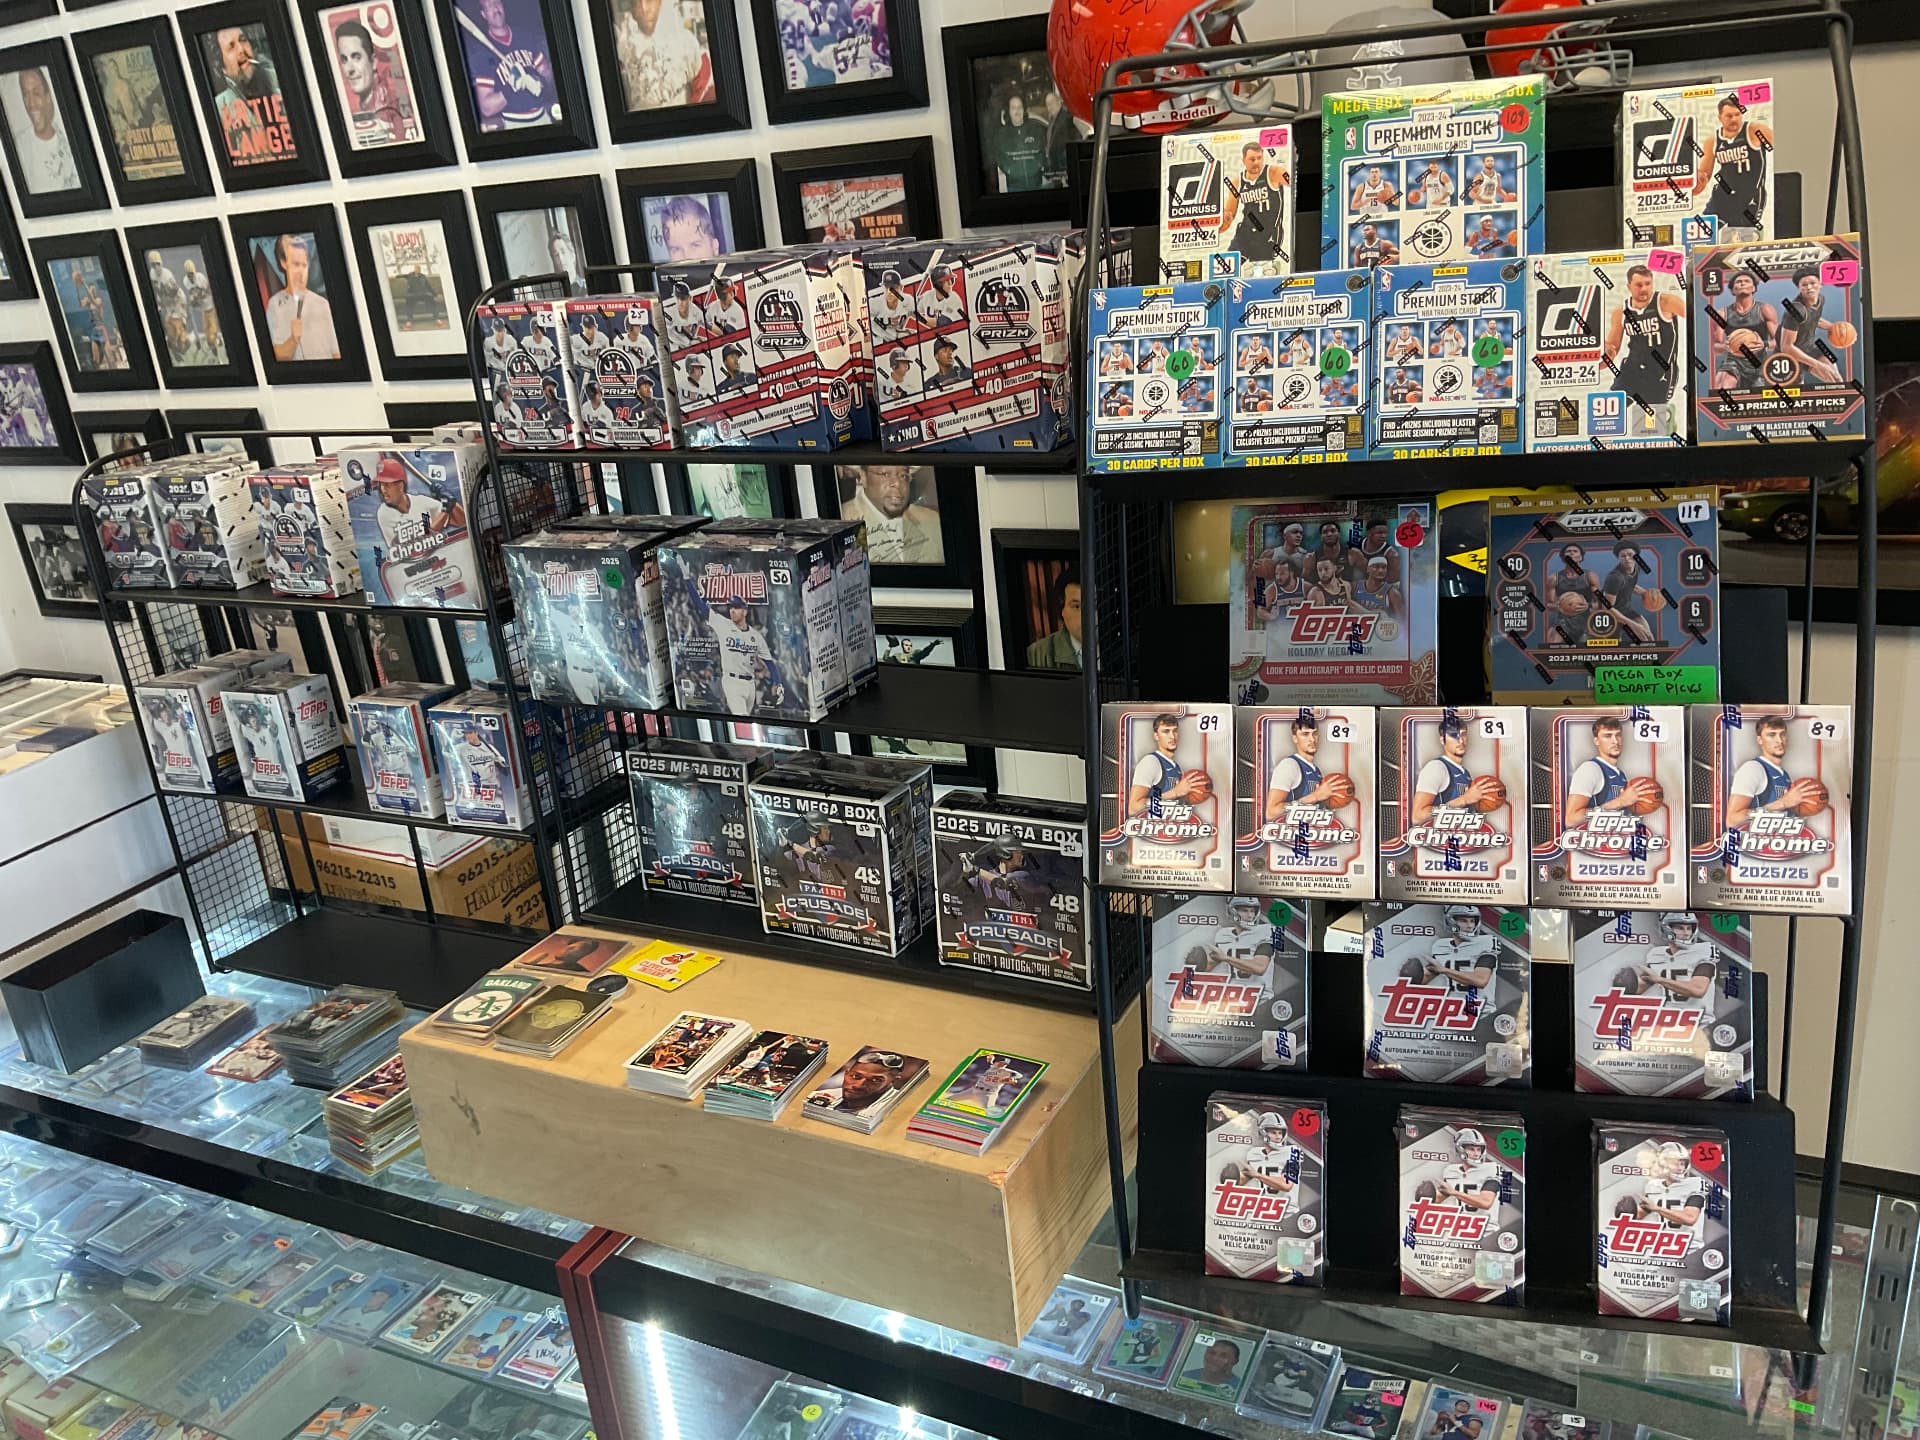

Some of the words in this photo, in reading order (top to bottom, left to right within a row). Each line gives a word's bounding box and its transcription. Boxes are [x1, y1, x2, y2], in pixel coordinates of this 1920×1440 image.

[1743, 85, 1769, 101] 75
[222, 94, 287, 130] ARTIE
[1171, 106, 1216, 121] Riddell
[1333, 100, 1369, 114] MEGA
[1418, 112, 1447, 122] 2023-24
[1506, 110, 1523, 124] 109
[1374, 124, 1441, 145] PREMIUM
[1446, 120, 1493, 137] STOCK
[225, 124, 295, 158] LANGE
[1398, 145, 1412, 154] NBA
[1413, 142, 1443, 153] TRADING
[1637, 165, 1690, 177] DONRUSS
[1734, 160, 1750, 174] 77
[1637, 192, 1689, 207] 2023-24
[1171, 205, 1217, 216] DONRUSS
[1656, 255, 1681, 269] 75
[1003, 271, 1020, 285] 40
[1709, 271, 1717, 284] 5
[1826, 267, 1848, 281] 75
[779, 289, 794, 300] 40
[1403, 295, 1457, 309] PREMIUM
[1115, 313, 1164, 328] PREMIUM
[1166, 311, 1200, 324] STOCK
[1253, 305, 1305, 320] PREMIUM
[1434, 309, 1458, 317] TRADING
[981, 329, 1029, 339] PRIZM
[761, 337, 804, 347] PRIZM
[1540, 336, 1597, 348] DONRUSS
[1479, 342, 1499, 357] 60
[1171, 357, 1189, 372] 60
[1325, 355, 1344, 370] 60
[1773, 359, 1790, 374] 30
[985, 379, 1002, 394] 40
[1592, 397, 1619, 416] 90
[1746, 402, 1778, 410] PRIZM
[1816, 398, 1846, 406] PICKS
[1452, 447, 1473, 457] PER
[1536, 440, 1591, 452] AUTOGRAPHS
[1107, 459, 1120, 470] 30
[1123, 459, 1157, 470] CARDS
[1160, 457, 1180, 468] PER
[1182, 456, 1204, 467] BOX
[1246, 456, 1260, 467] 30
[1301, 454, 1322, 464] PER
[1325, 452, 1348, 463] BOX
[1681, 504, 1703, 519] 119
[388, 531, 444, 562] Chrome
[769, 559, 789, 568] 2025
[810, 551, 823, 562] 2025
[1688, 554, 1703, 569] 10
[772, 572, 788, 584] 50
[1504, 611, 1527, 619] GREEN
[1691, 602, 1700, 616] 6
[1505, 619, 1527, 627] PRIZM
[1595, 615, 1609, 627] 60
[1356, 665, 1376, 674] RELIC
[1200, 715, 1218, 731] 89
[1484, 721, 1505, 735] 89
[1811, 722, 1835, 738] 89
[1331, 725, 1349, 738] 89
[1639, 724, 1660, 738] 89
[632, 758, 665, 771] 2025
[713, 766, 740, 778] BOX
[755, 792, 790, 809] 2025
[796, 799, 838, 815] MEGA
[844, 806, 876, 821] BOX
[722, 823, 745, 839] 48
[937, 816, 979, 833] 2025
[985, 822, 1035, 841] MEGA
[1042, 829, 1078, 844] BOX
[1124, 819, 1213, 838] Chrome
[1139, 850, 1197, 861] 2025/26
[1277, 855, 1338, 868] 2025/26
[661, 855, 732, 873] CRUSADE
[763, 865, 770, 875] 6
[1579, 864, 1645, 876] 2025/26
[315, 859, 396, 889] 96215-22315
[1739, 866, 1808, 879] 2025/26
[765, 877, 772, 886] 8
[463, 878, 500, 916] HALL
[942, 893, 950, 902] 6
[1765, 888, 1804, 896] EXCLUSIVE
[786, 898, 865, 919] CRUSADE
[1050, 894, 1079, 913] 48
[968, 926, 1058, 948] CRUSADE
[639, 960, 677, 974] CLEVELAND
[484, 979, 534, 990] OAKLAND
[1430, 1032, 1476, 1042] FOOTBALL
[1501, 1137, 1520, 1150] 35
[1621, 1278, 1641, 1287] RELIC
[1642, 1280, 1668, 1289] CARDS!
[1479, 1402, 1496, 1411] 140
